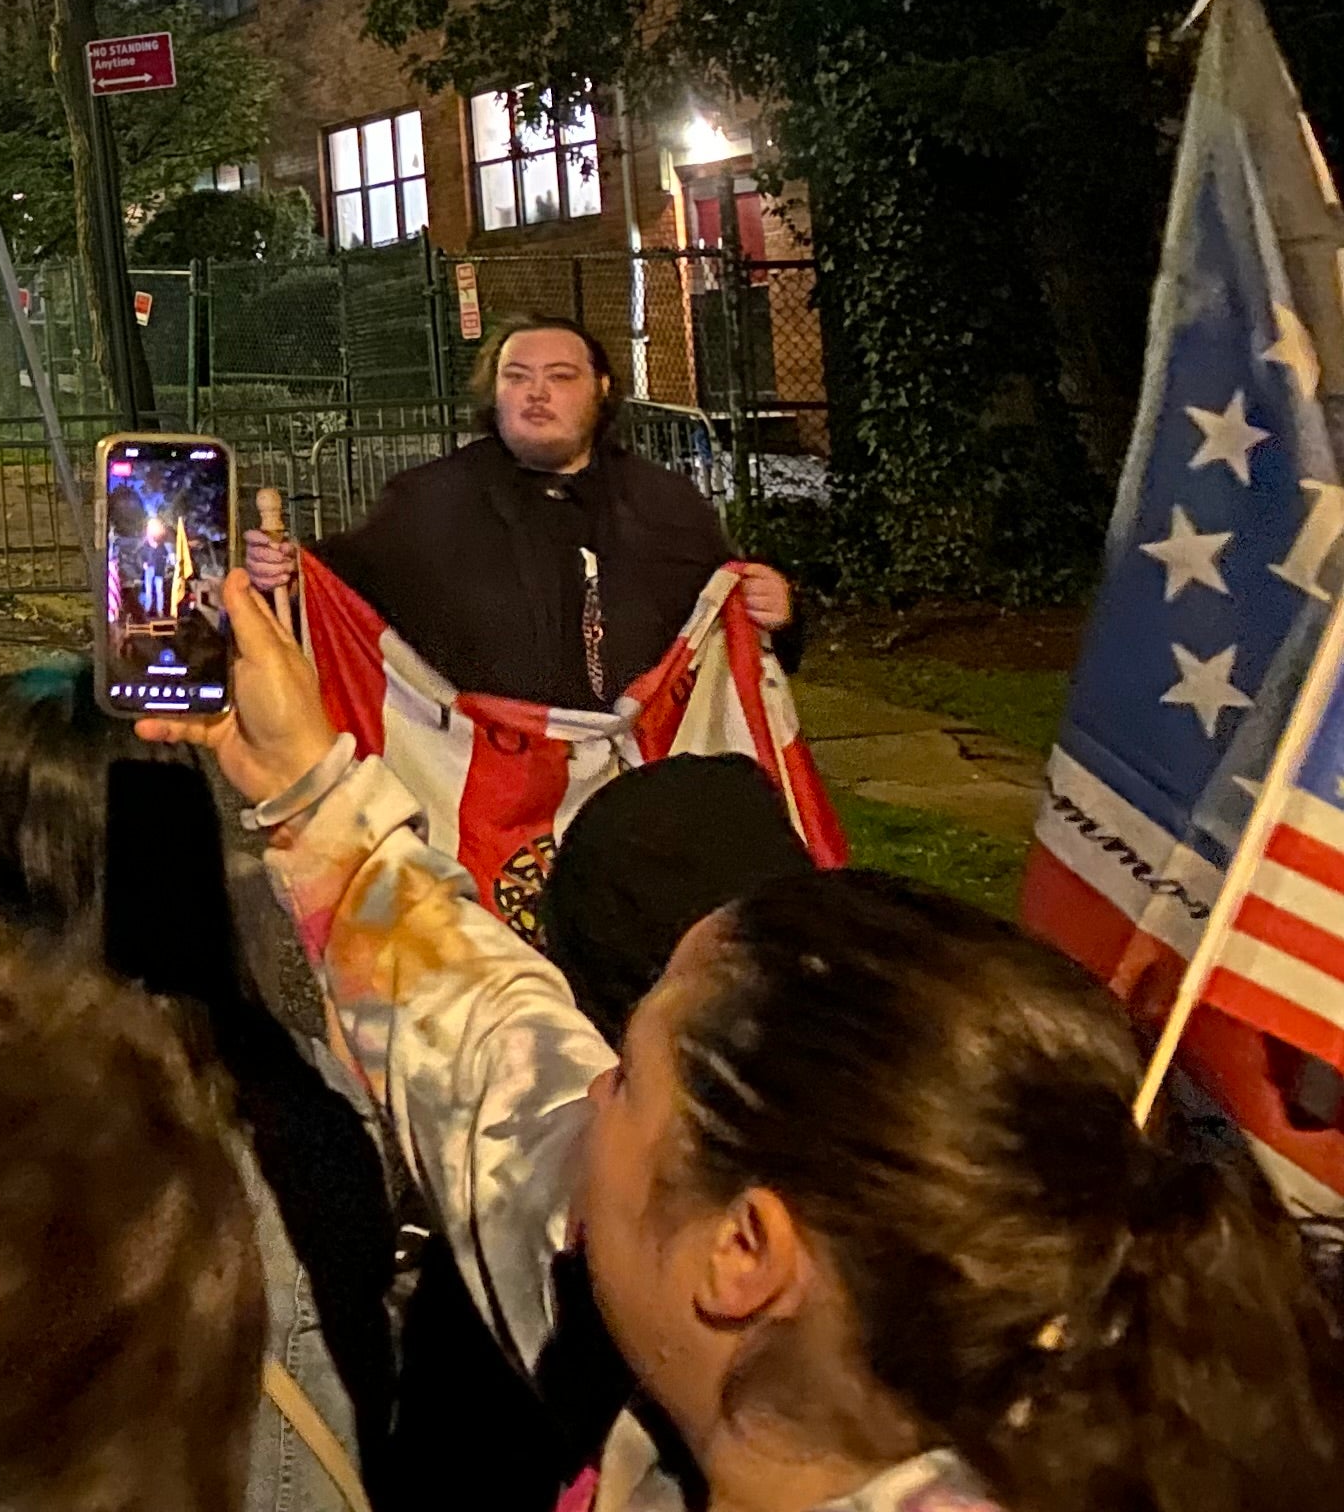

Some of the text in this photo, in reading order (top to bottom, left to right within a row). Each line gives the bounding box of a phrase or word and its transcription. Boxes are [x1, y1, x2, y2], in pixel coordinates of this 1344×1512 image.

[92, 40, 159, 57] NO STANDING
[95, 57, 136, 70] Anytime
